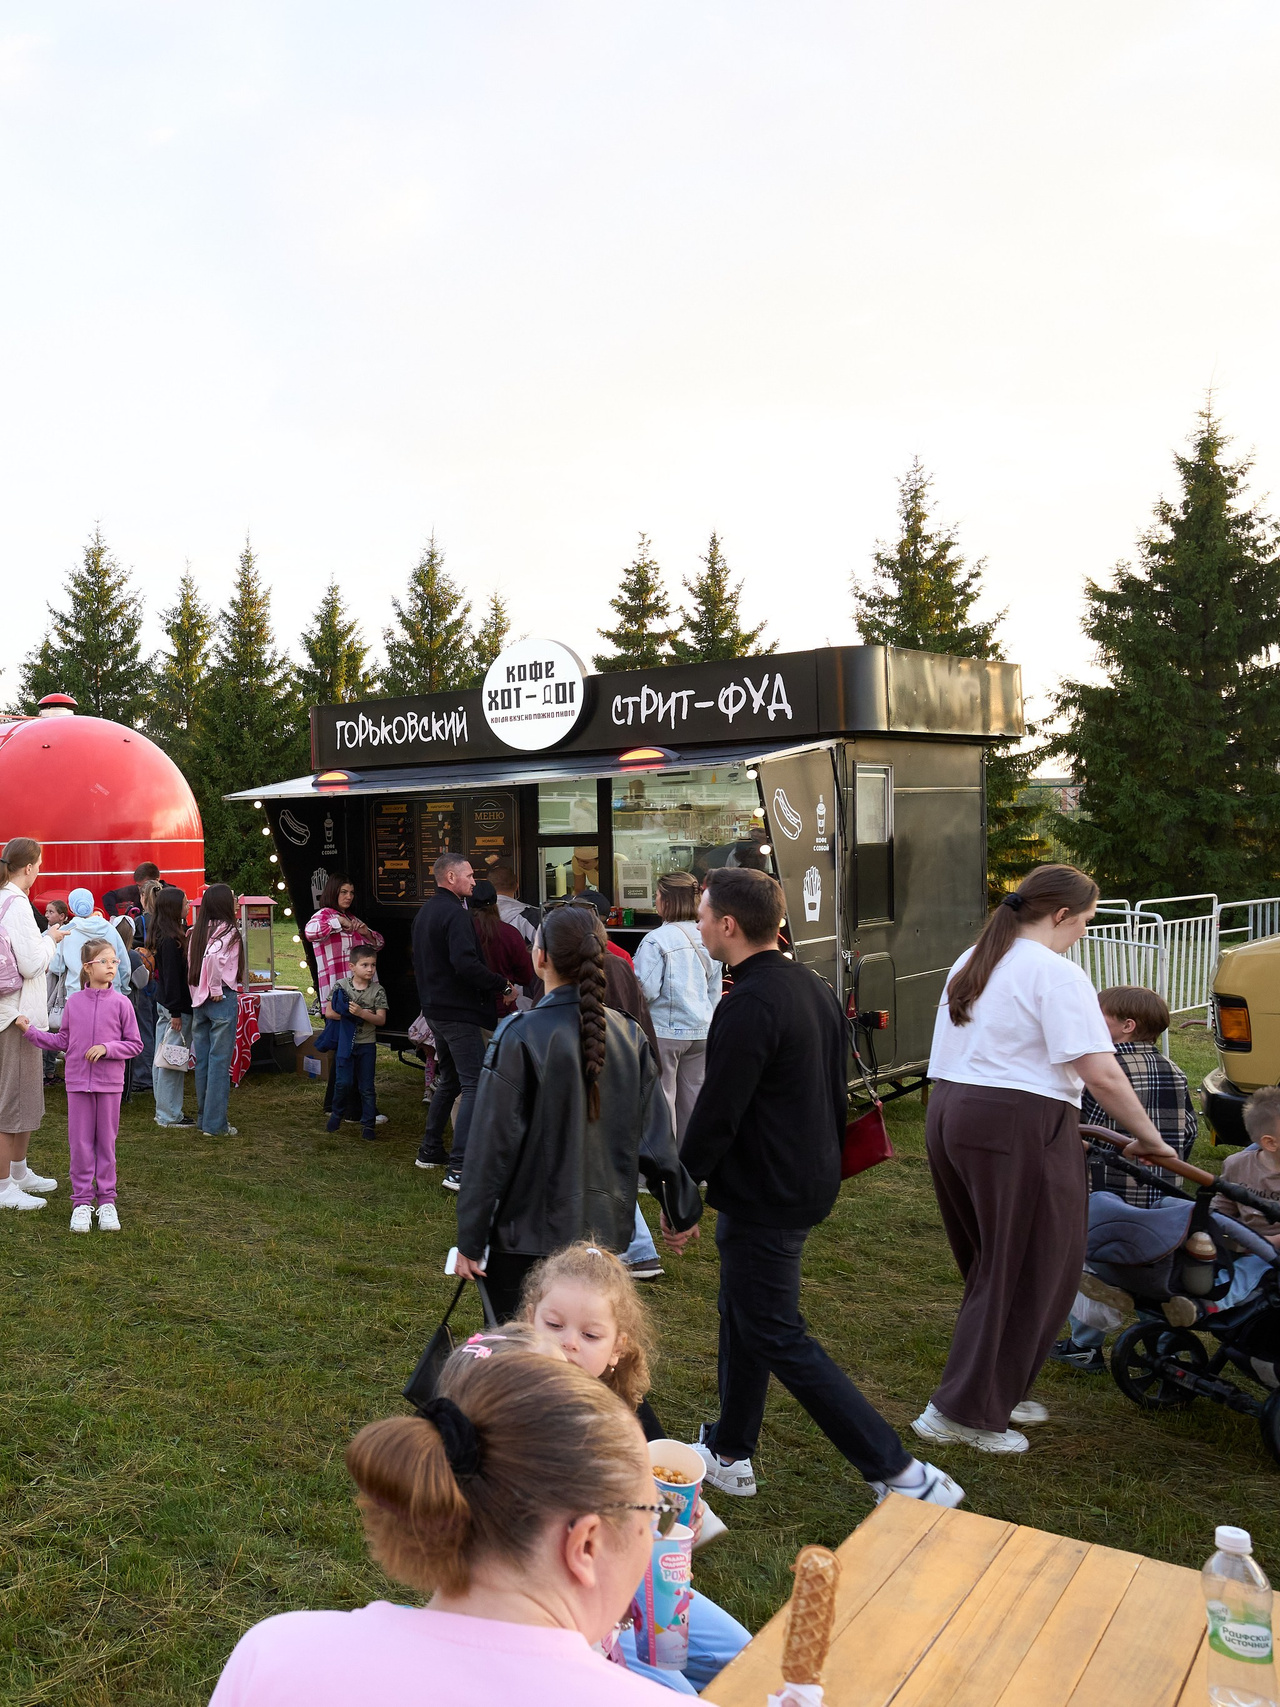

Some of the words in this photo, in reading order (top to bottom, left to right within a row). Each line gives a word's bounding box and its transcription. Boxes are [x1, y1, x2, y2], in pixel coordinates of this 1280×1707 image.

[506, 660, 555, 683] КОФЕ
[335, 705, 470, 750] ГОРЬКОВСКИЙ
[474, 811, 505, 820] МЕНЮ
